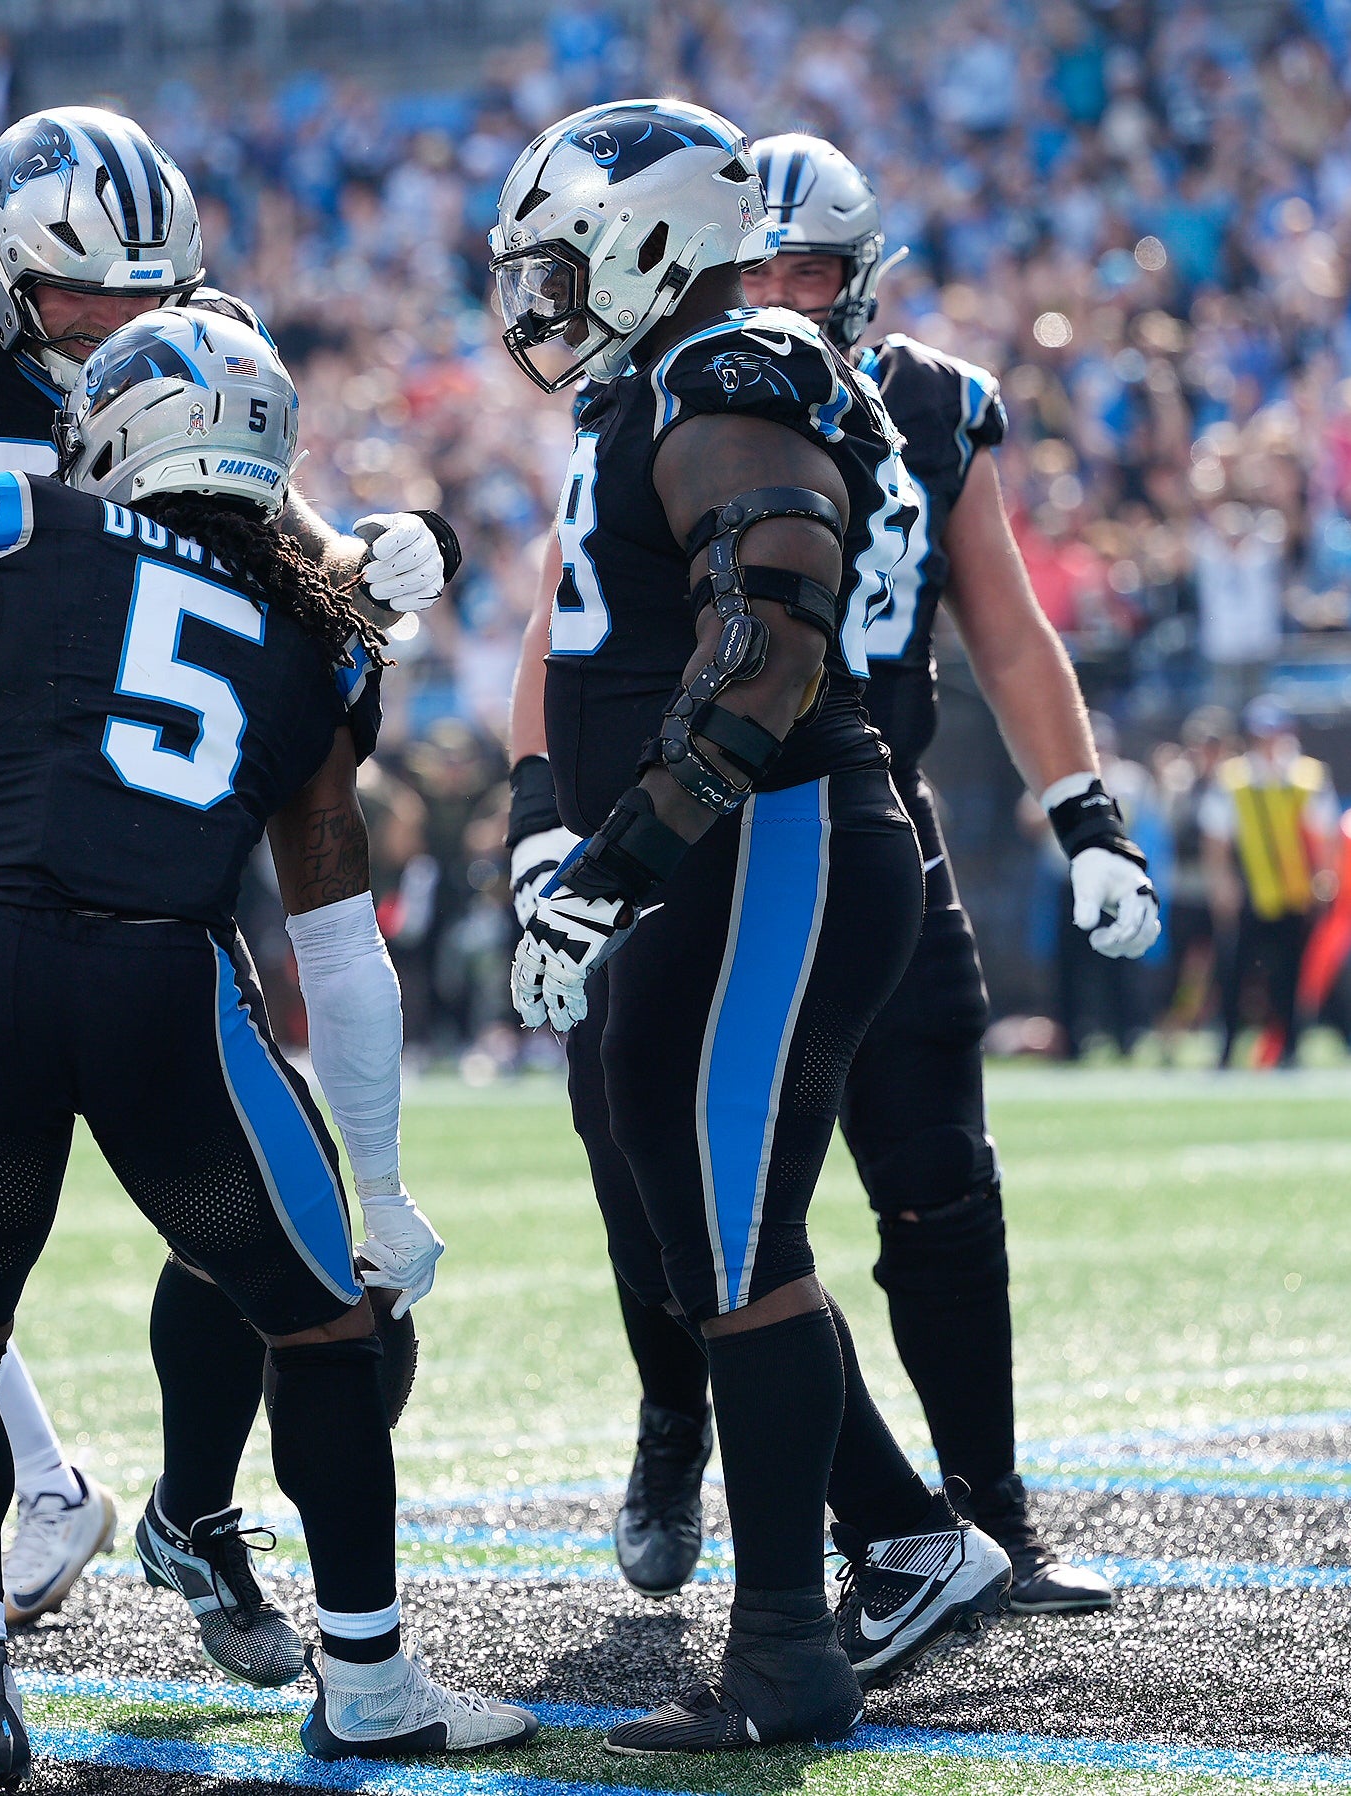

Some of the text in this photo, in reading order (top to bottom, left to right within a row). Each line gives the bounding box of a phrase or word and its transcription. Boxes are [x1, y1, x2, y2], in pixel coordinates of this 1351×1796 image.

[248, 397, 268, 434] 5
[215, 459, 279, 485] PANTHERS
[723, 622, 740, 663] DONJOY
[100, 553, 270, 812] 5
